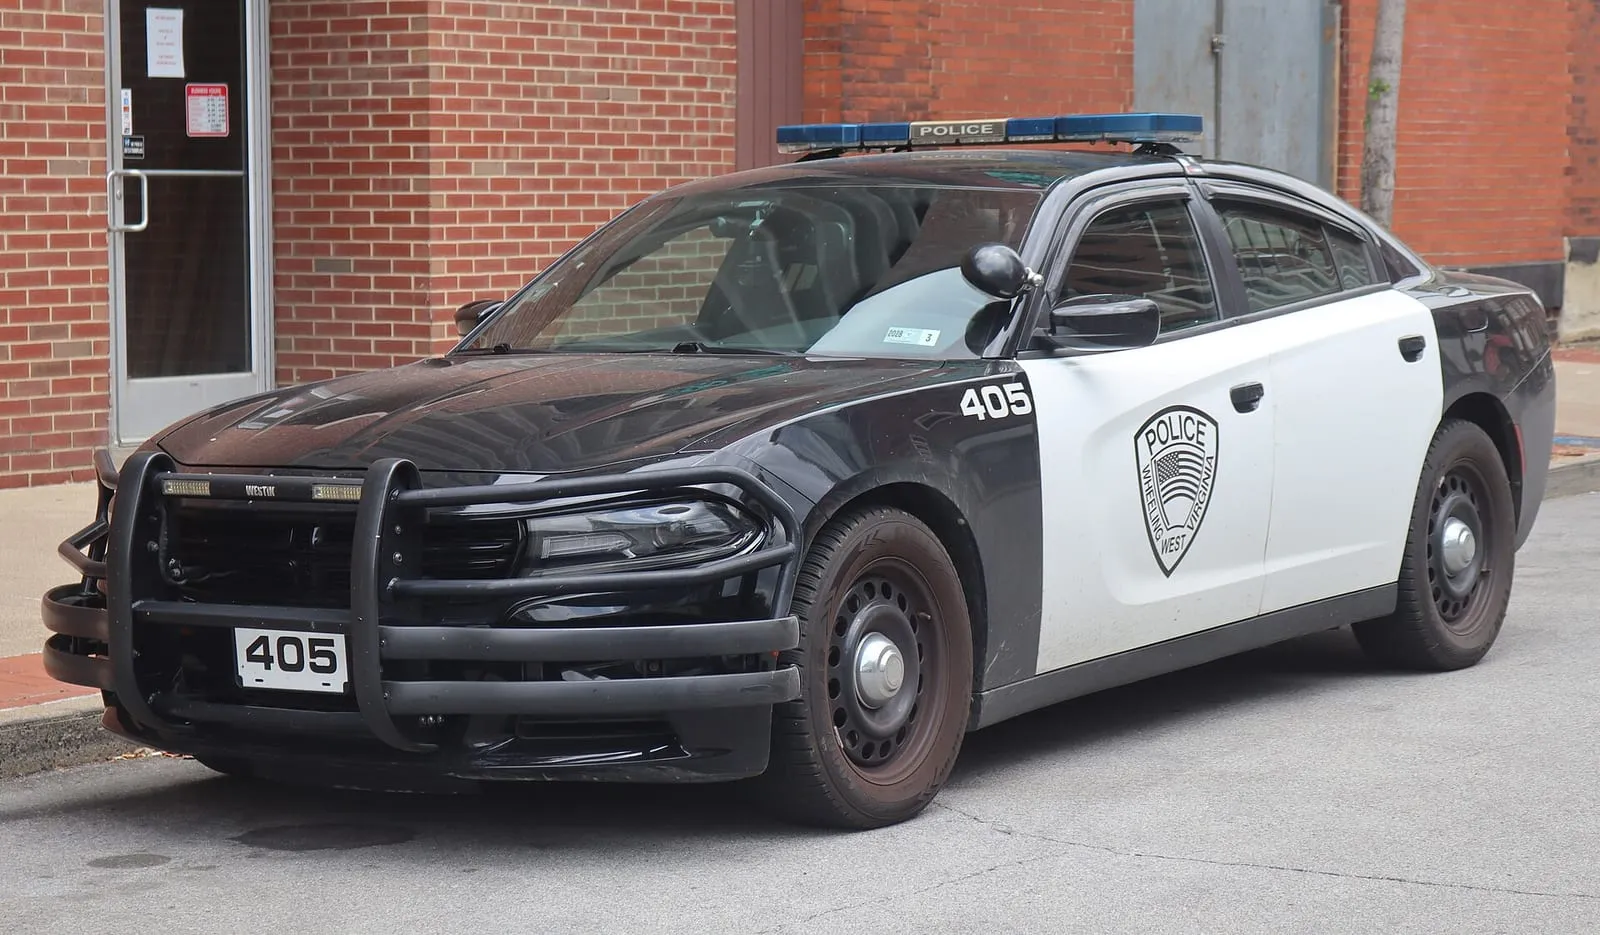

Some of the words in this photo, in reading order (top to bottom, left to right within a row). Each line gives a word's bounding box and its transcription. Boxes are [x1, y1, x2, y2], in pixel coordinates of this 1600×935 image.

[920, 124, 993, 136] POLICE
[925, 333, 933, 342] 3
[960, 382, 1032, 421] 405
[1144, 415, 1206, 455] POLICE
[245, 485, 275, 497] WESTIN
[1142, 464, 1163, 541] WHEELING
[1161, 534, 1186, 555] WEST
[1187, 455, 1215, 531] VIRGINIA
[246, 635, 338, 675] 405
